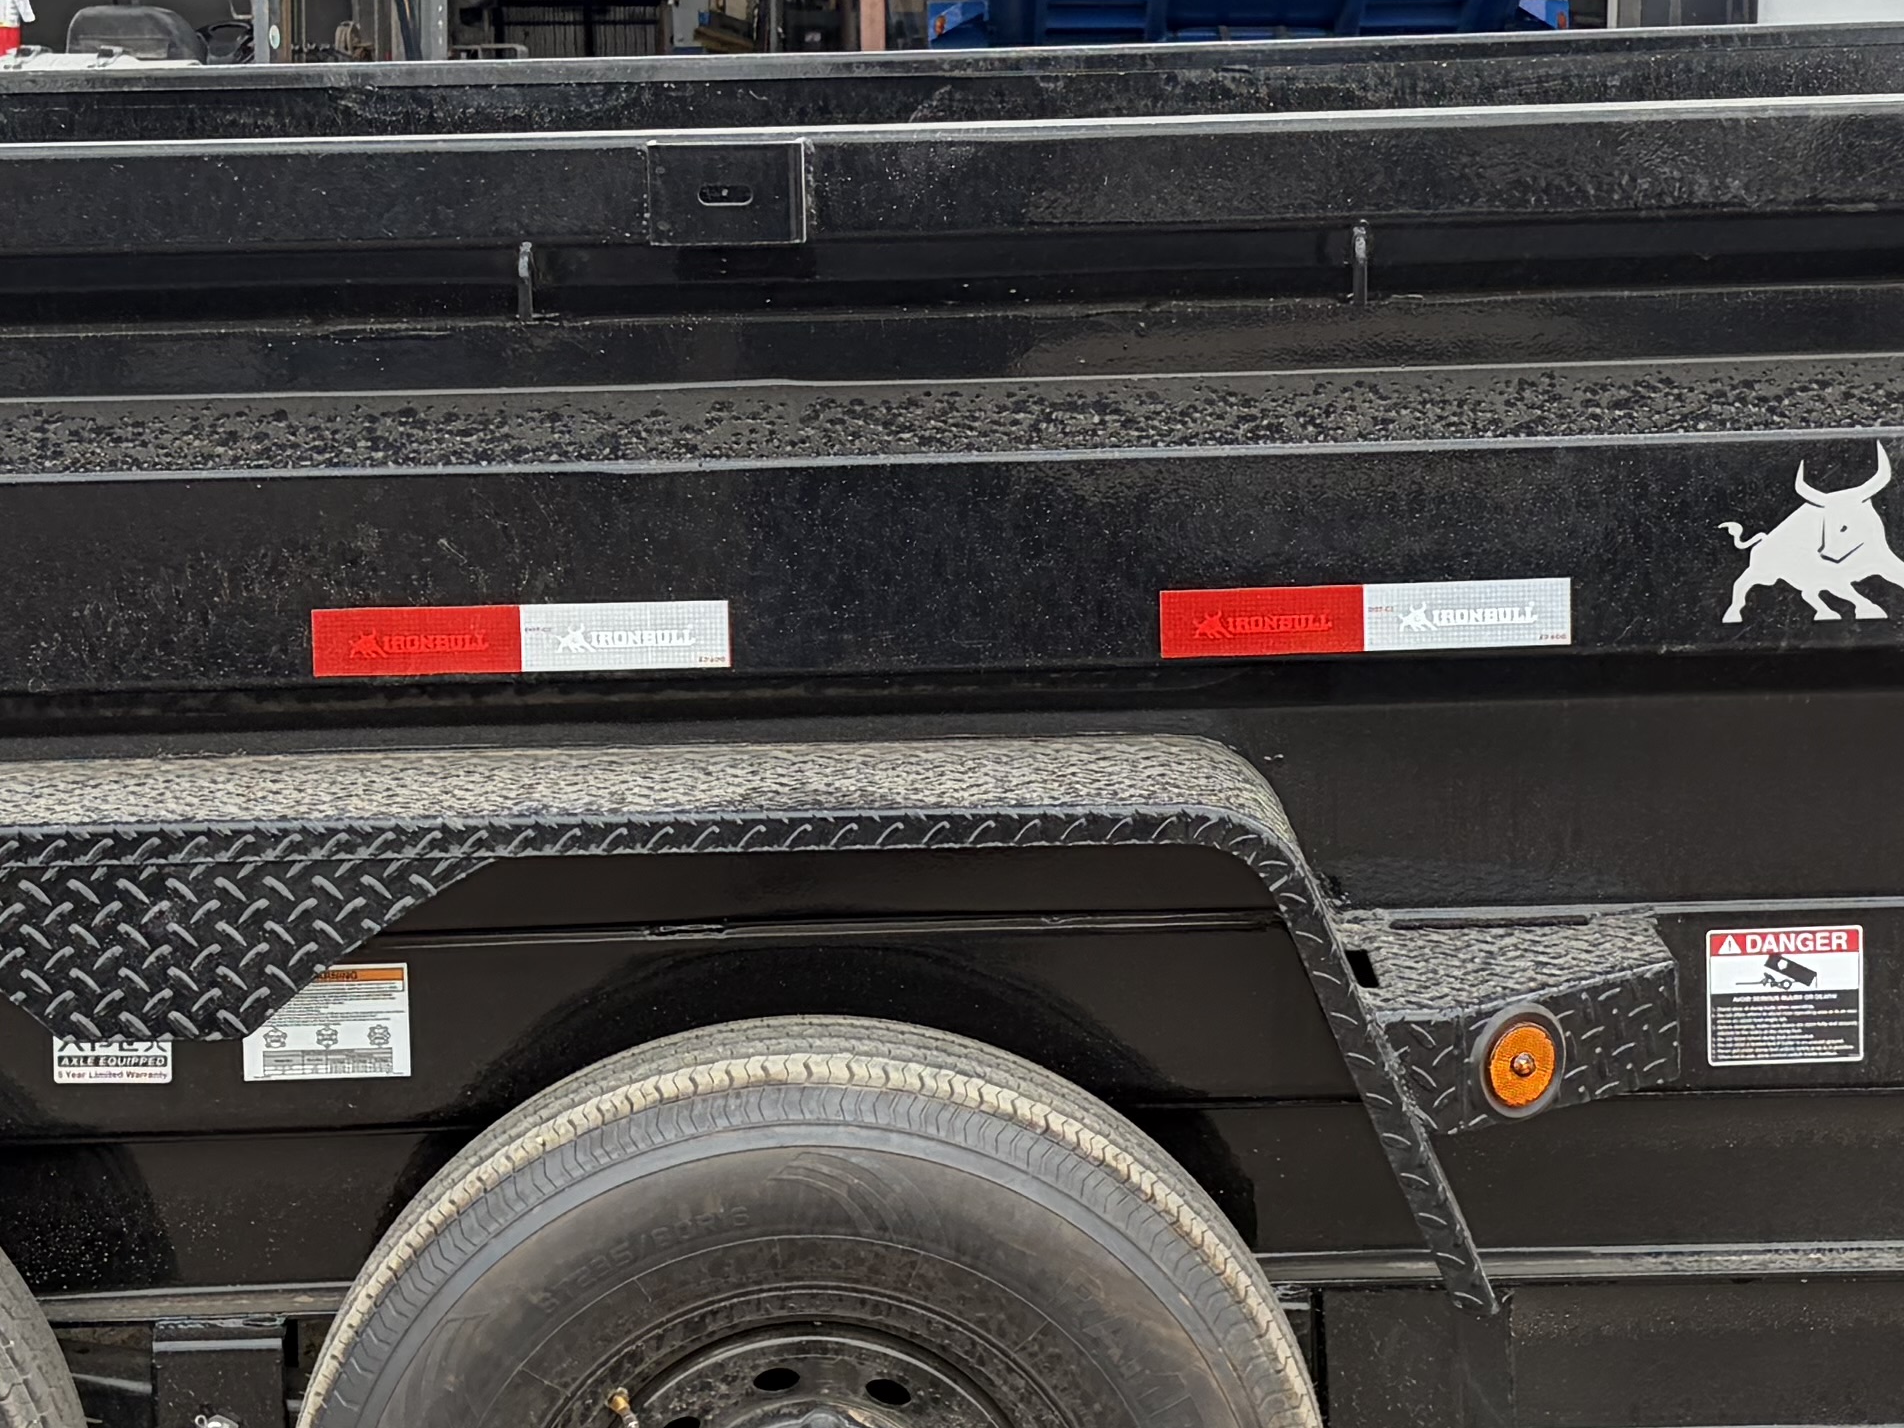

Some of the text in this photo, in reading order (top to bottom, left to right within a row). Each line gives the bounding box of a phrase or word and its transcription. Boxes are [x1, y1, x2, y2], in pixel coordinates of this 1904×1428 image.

[1228, 615, 1332, 633] IRONBULL
[1432, 603, 1538, 626] IRONBULL
[384, 632, 490, 653] IRONBULL
[590, 627, 696, 648] IRONBULL
[1745, 931, 1848, 953] DANGER
[61, 1056, 165, 1067] AXLE EQUIPPED
[66, 1070, 86, 1079] Year
[88, 1070, 124, 1079] Limited
[126, 1070, 168, 1080] Warranty
